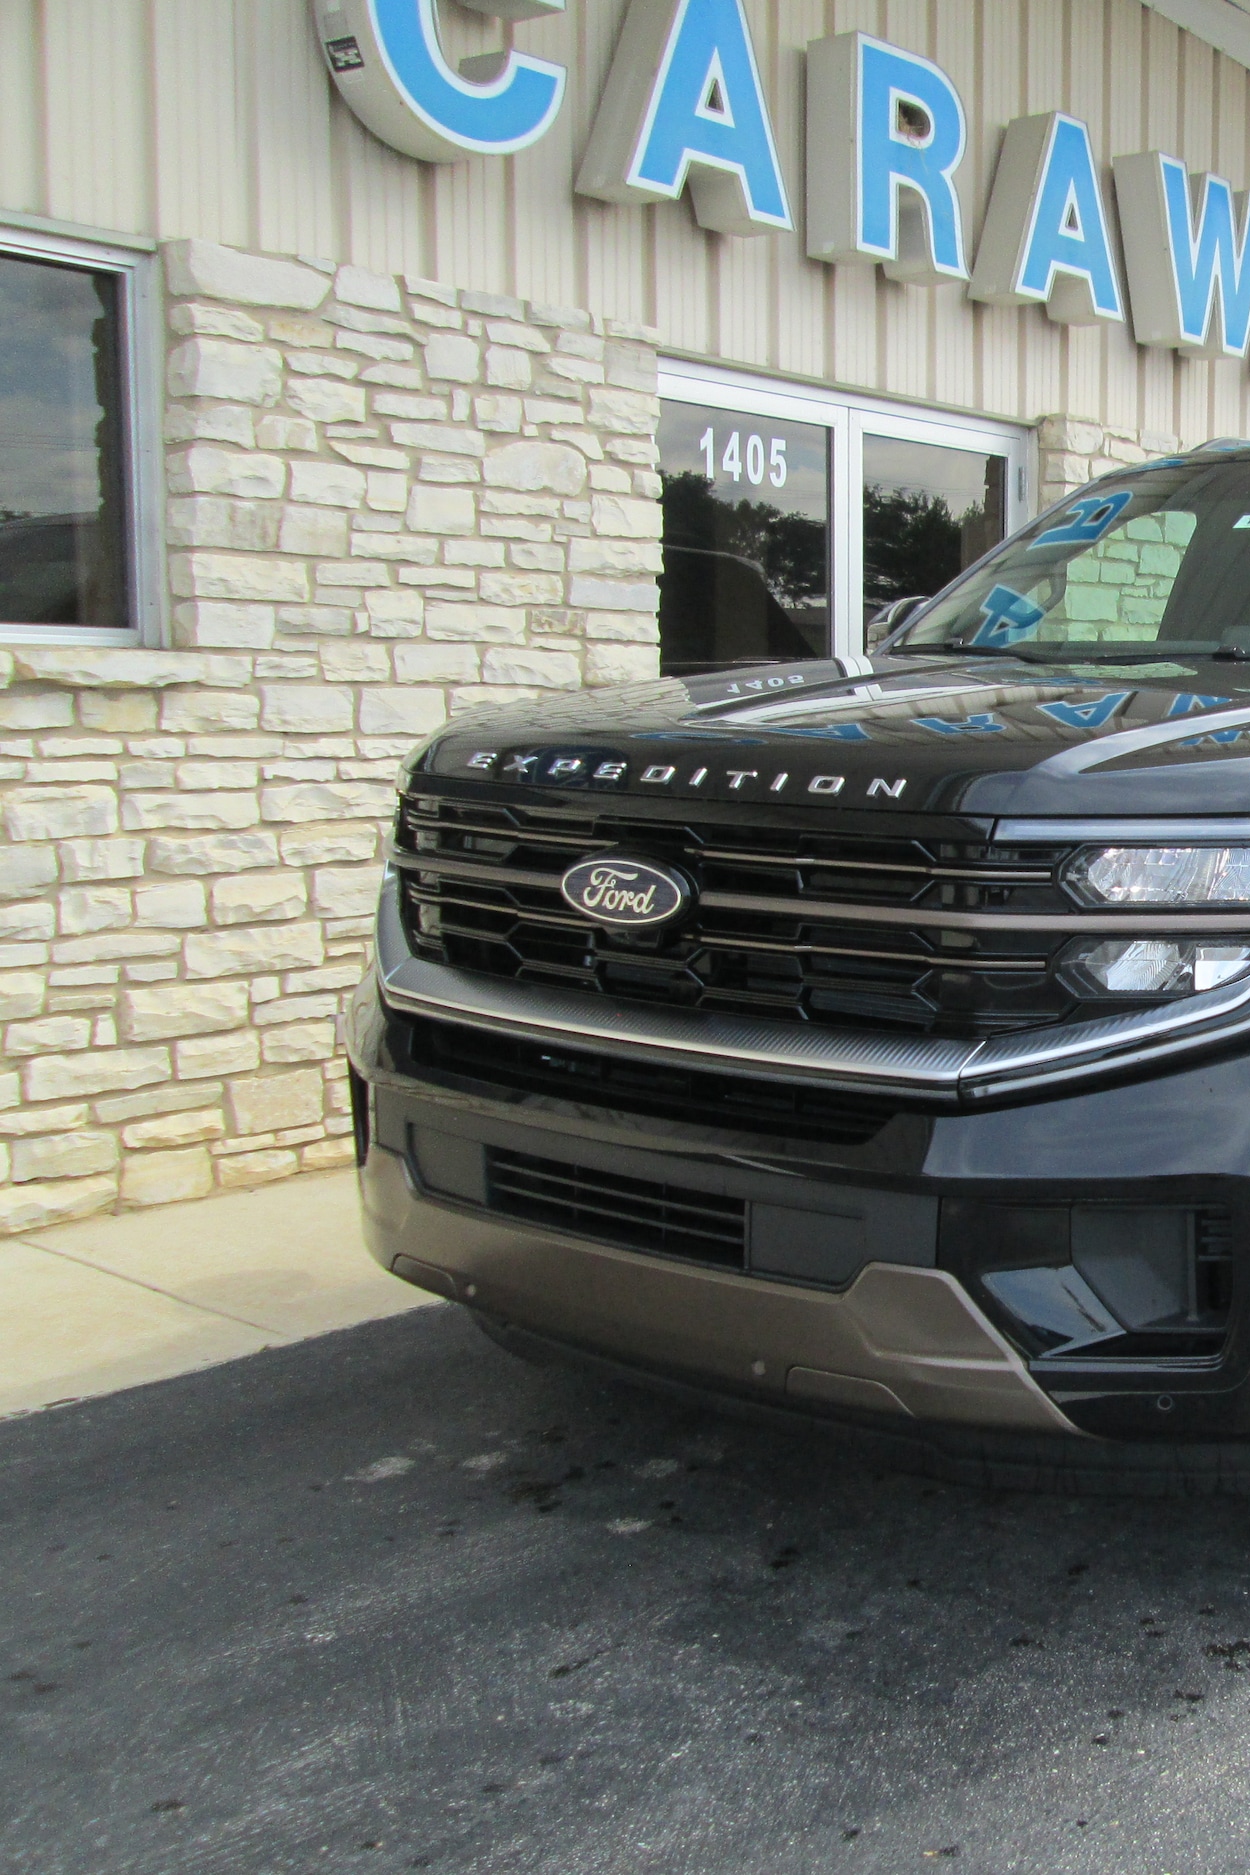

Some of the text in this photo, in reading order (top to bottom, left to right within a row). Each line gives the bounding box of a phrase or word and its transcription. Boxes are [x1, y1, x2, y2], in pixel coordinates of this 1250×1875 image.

[700, 427, 787, 488] 1405
[466, 751, 908, 799] EXPEDITION
[583, 867, 657, 915] Ford
